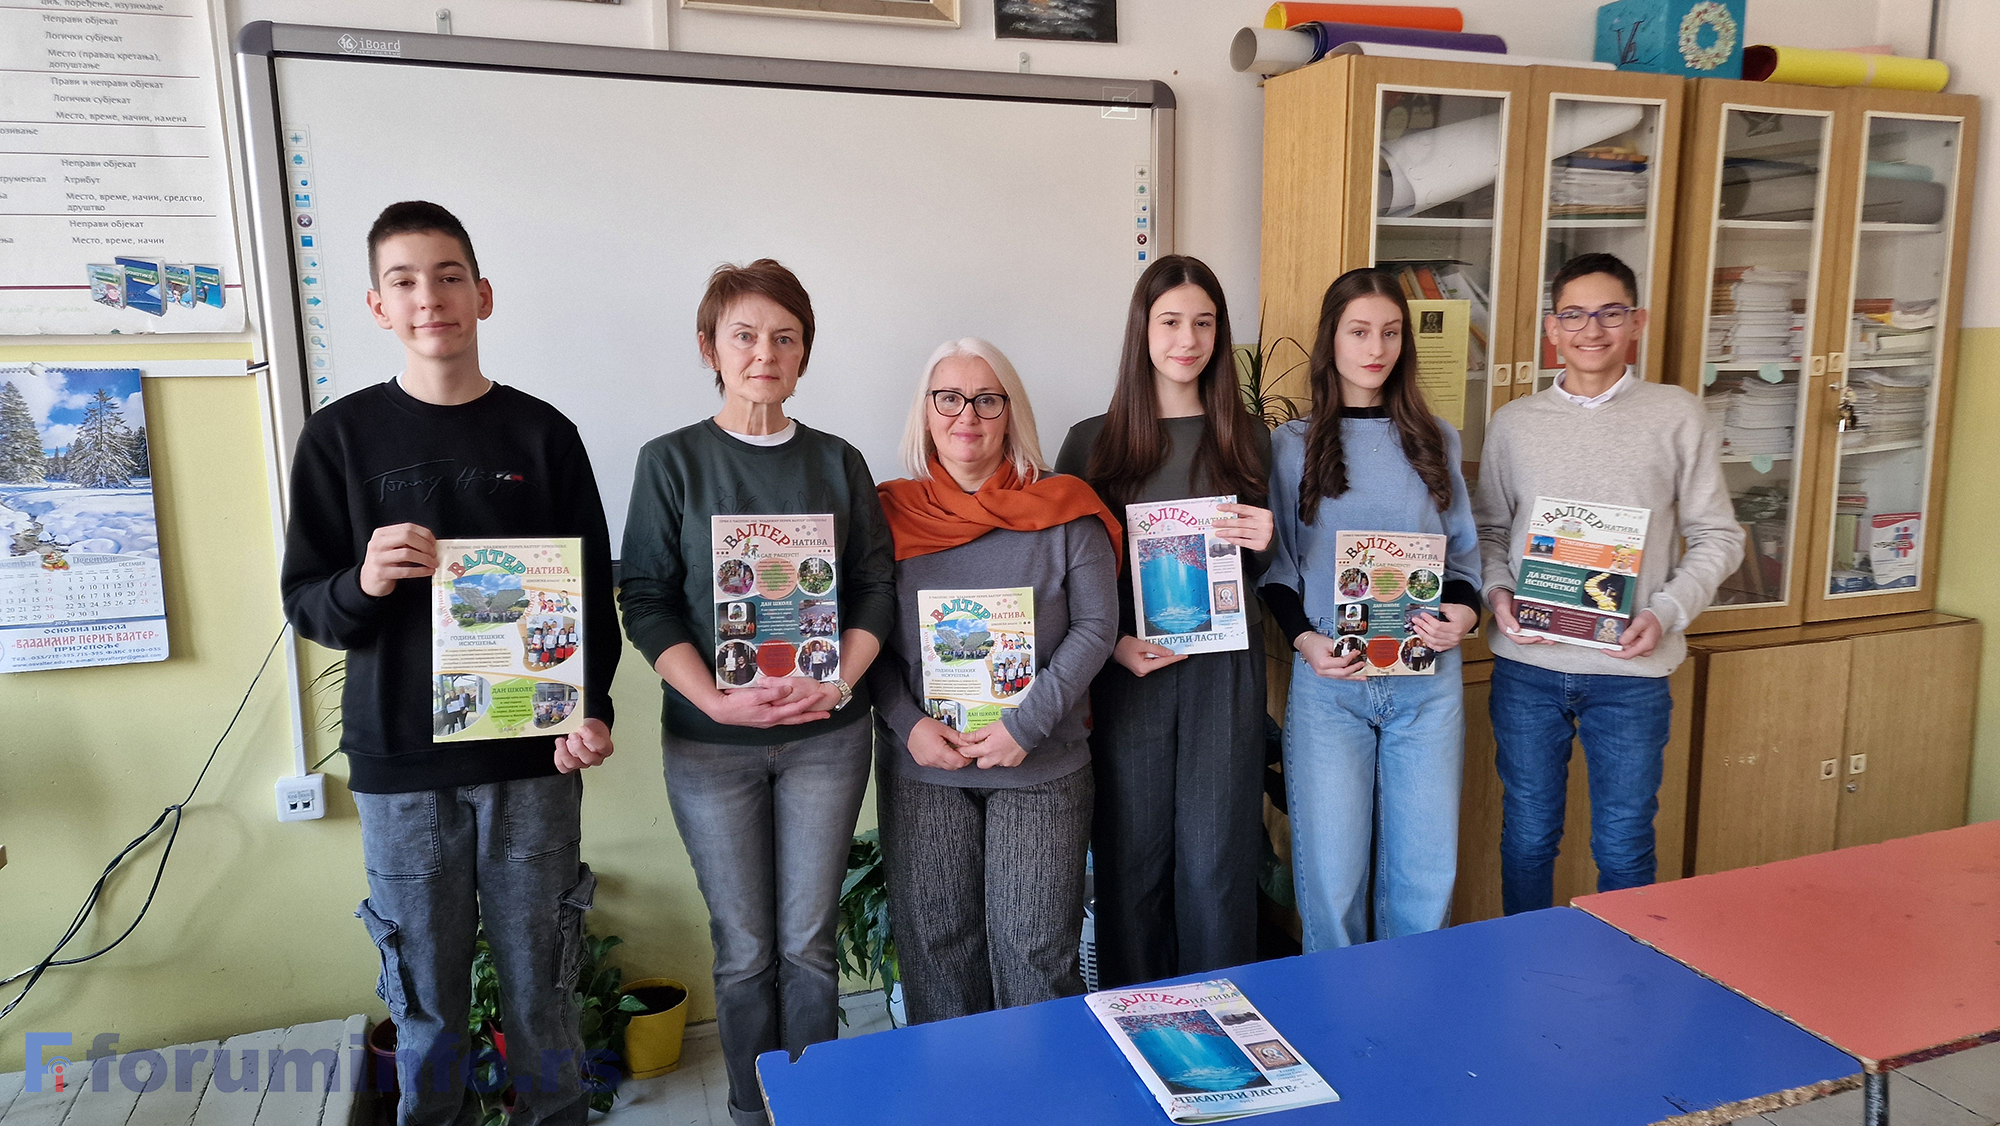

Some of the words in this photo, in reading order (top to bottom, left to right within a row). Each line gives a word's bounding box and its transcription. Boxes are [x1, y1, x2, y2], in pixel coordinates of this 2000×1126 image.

[42, 14, 82, 24] Неправи
[85, 16, 119, 26] објекат
[44, 31, 83, 41] Логички
[85, 34, 123, 43] субјекат
[360, 38, 401, 51] iBoard
[48, 49, 76, 59] Место
[78, 50, 115, 61] (правац
[117, 52, 161, 62] кретања),
[49, 61, 100, 70] допуштање
[51, 77, 80, 88] Прави
[90, 80, 128, 89] неправи
[130, 79, 164, 90] објекат
[53, 94, 91, 104] Логички
[93, 96, 131, 105] субјекат
[56, 111, 87, 121] Место,
[89, 113, 119, 122] време,
[122, 115, 153, 123] начин,
[154, 115, 187, 123] намена
[61, 159, 101, 168] Неправи
[103, 160, 136, 170] објекат
[64, 176, 100, 185] Атрибут
[66, 193, 98, 201] Место,
[100, 194, 130, 202] време,
[164, 194, 205, 203] средство,
[67, 204, 105, 213] друштво
[69, 220, 109, 229] Неправи
[111, 220, 144, 230] објекат
[72, 237, 104, 245] Место,
[105, 237, 136, 245] време,
[138, 237, 165, 245] начин
[73, 556, 117, 565] Decembar
[1541, 573, 1582, 585] КРЕНЕМО
[1525, 578, 1579, 593] ИСПОЧЕТКА!
[79, 633, 114, 645] ПЕРИЋ
[1194, 633, 1224, 642] ЛАСТЕ
[1249, 1085, 1296, 1097] ЛАСТЕ
